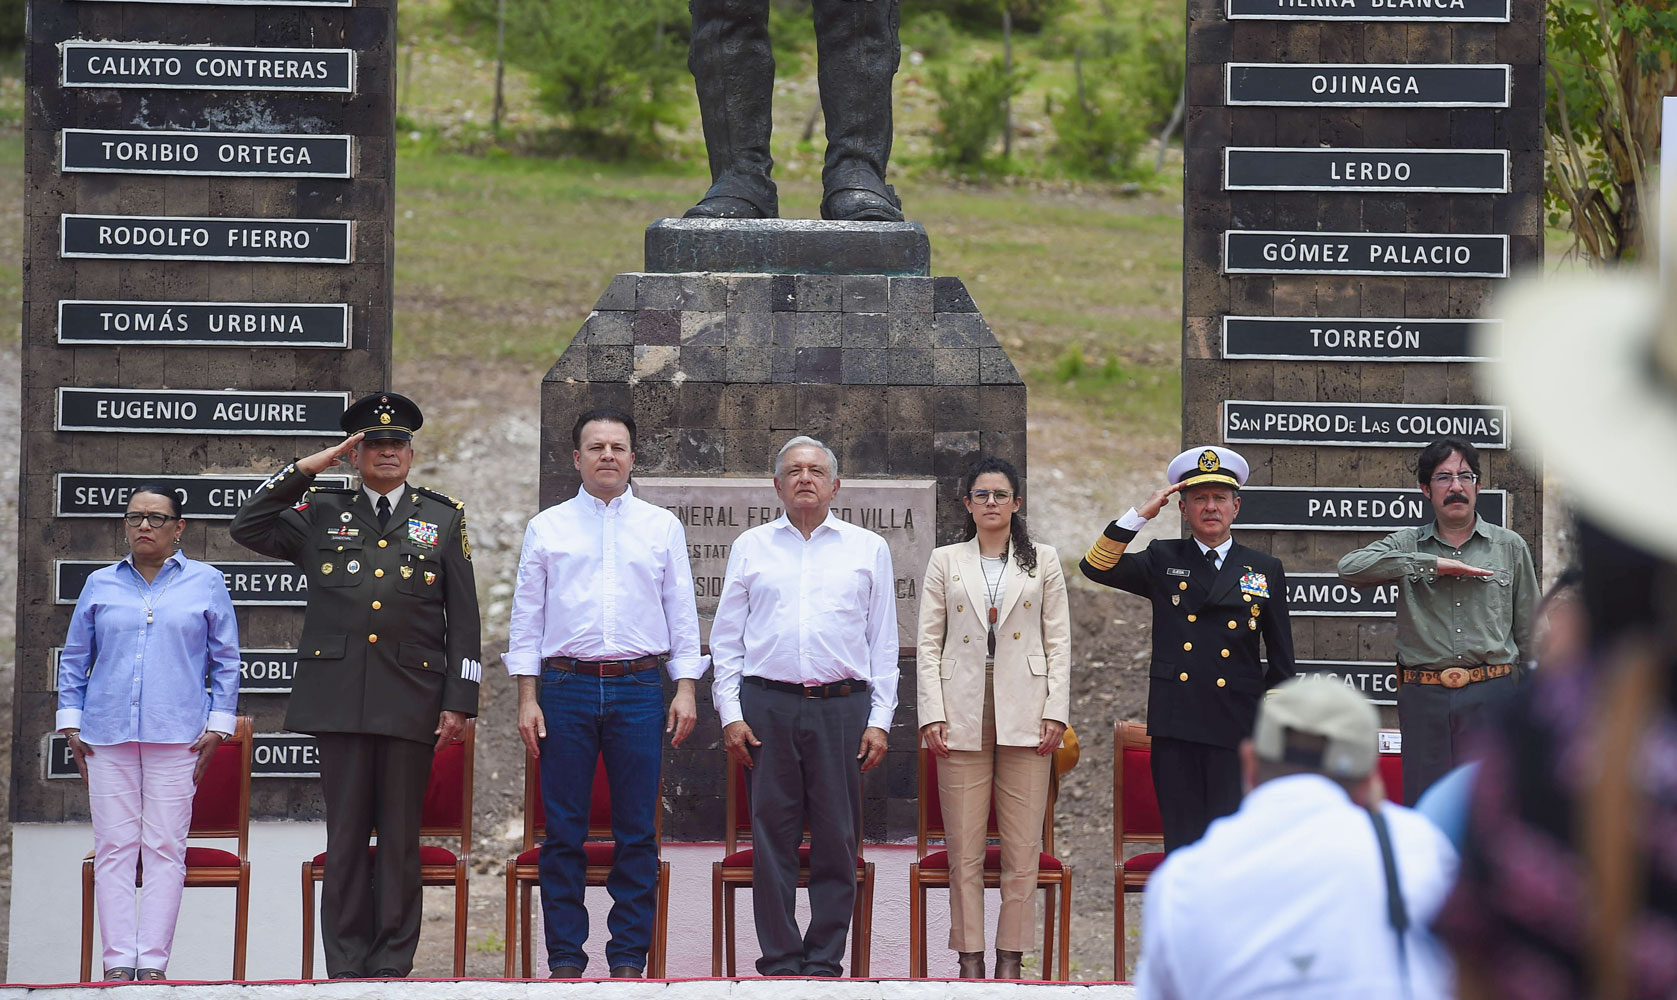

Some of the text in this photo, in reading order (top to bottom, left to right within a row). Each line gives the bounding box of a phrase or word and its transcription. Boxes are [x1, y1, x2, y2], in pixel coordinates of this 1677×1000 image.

[86, 52, 328, 80] CALIXTO CONTRERAS
[1311, 75, 1420, 95] OJINAGA
[101, 141, 312, 165] TORIBIO ORTEGA
[1331, 161, 1412, 182] LERDO
[99, 226, 310, 250] RODOLFO FIERRO
[1262, 238, 1472, 266] GÓMEZ PALACIO
[100, 308, 304, 334] TOMÁS URBINA
[1309, 325, 1421, 350] TORREÓN
[96, 400, 307, 423] EUGENIO AGUIRRE
[1264, 413, 1331, 434] PEDRO
[1396, 415, 1501, 437] COLONIAS
[860, 507, 914, 530] VILLA
[1307, 494, 1424, 520] PAREDÓN
